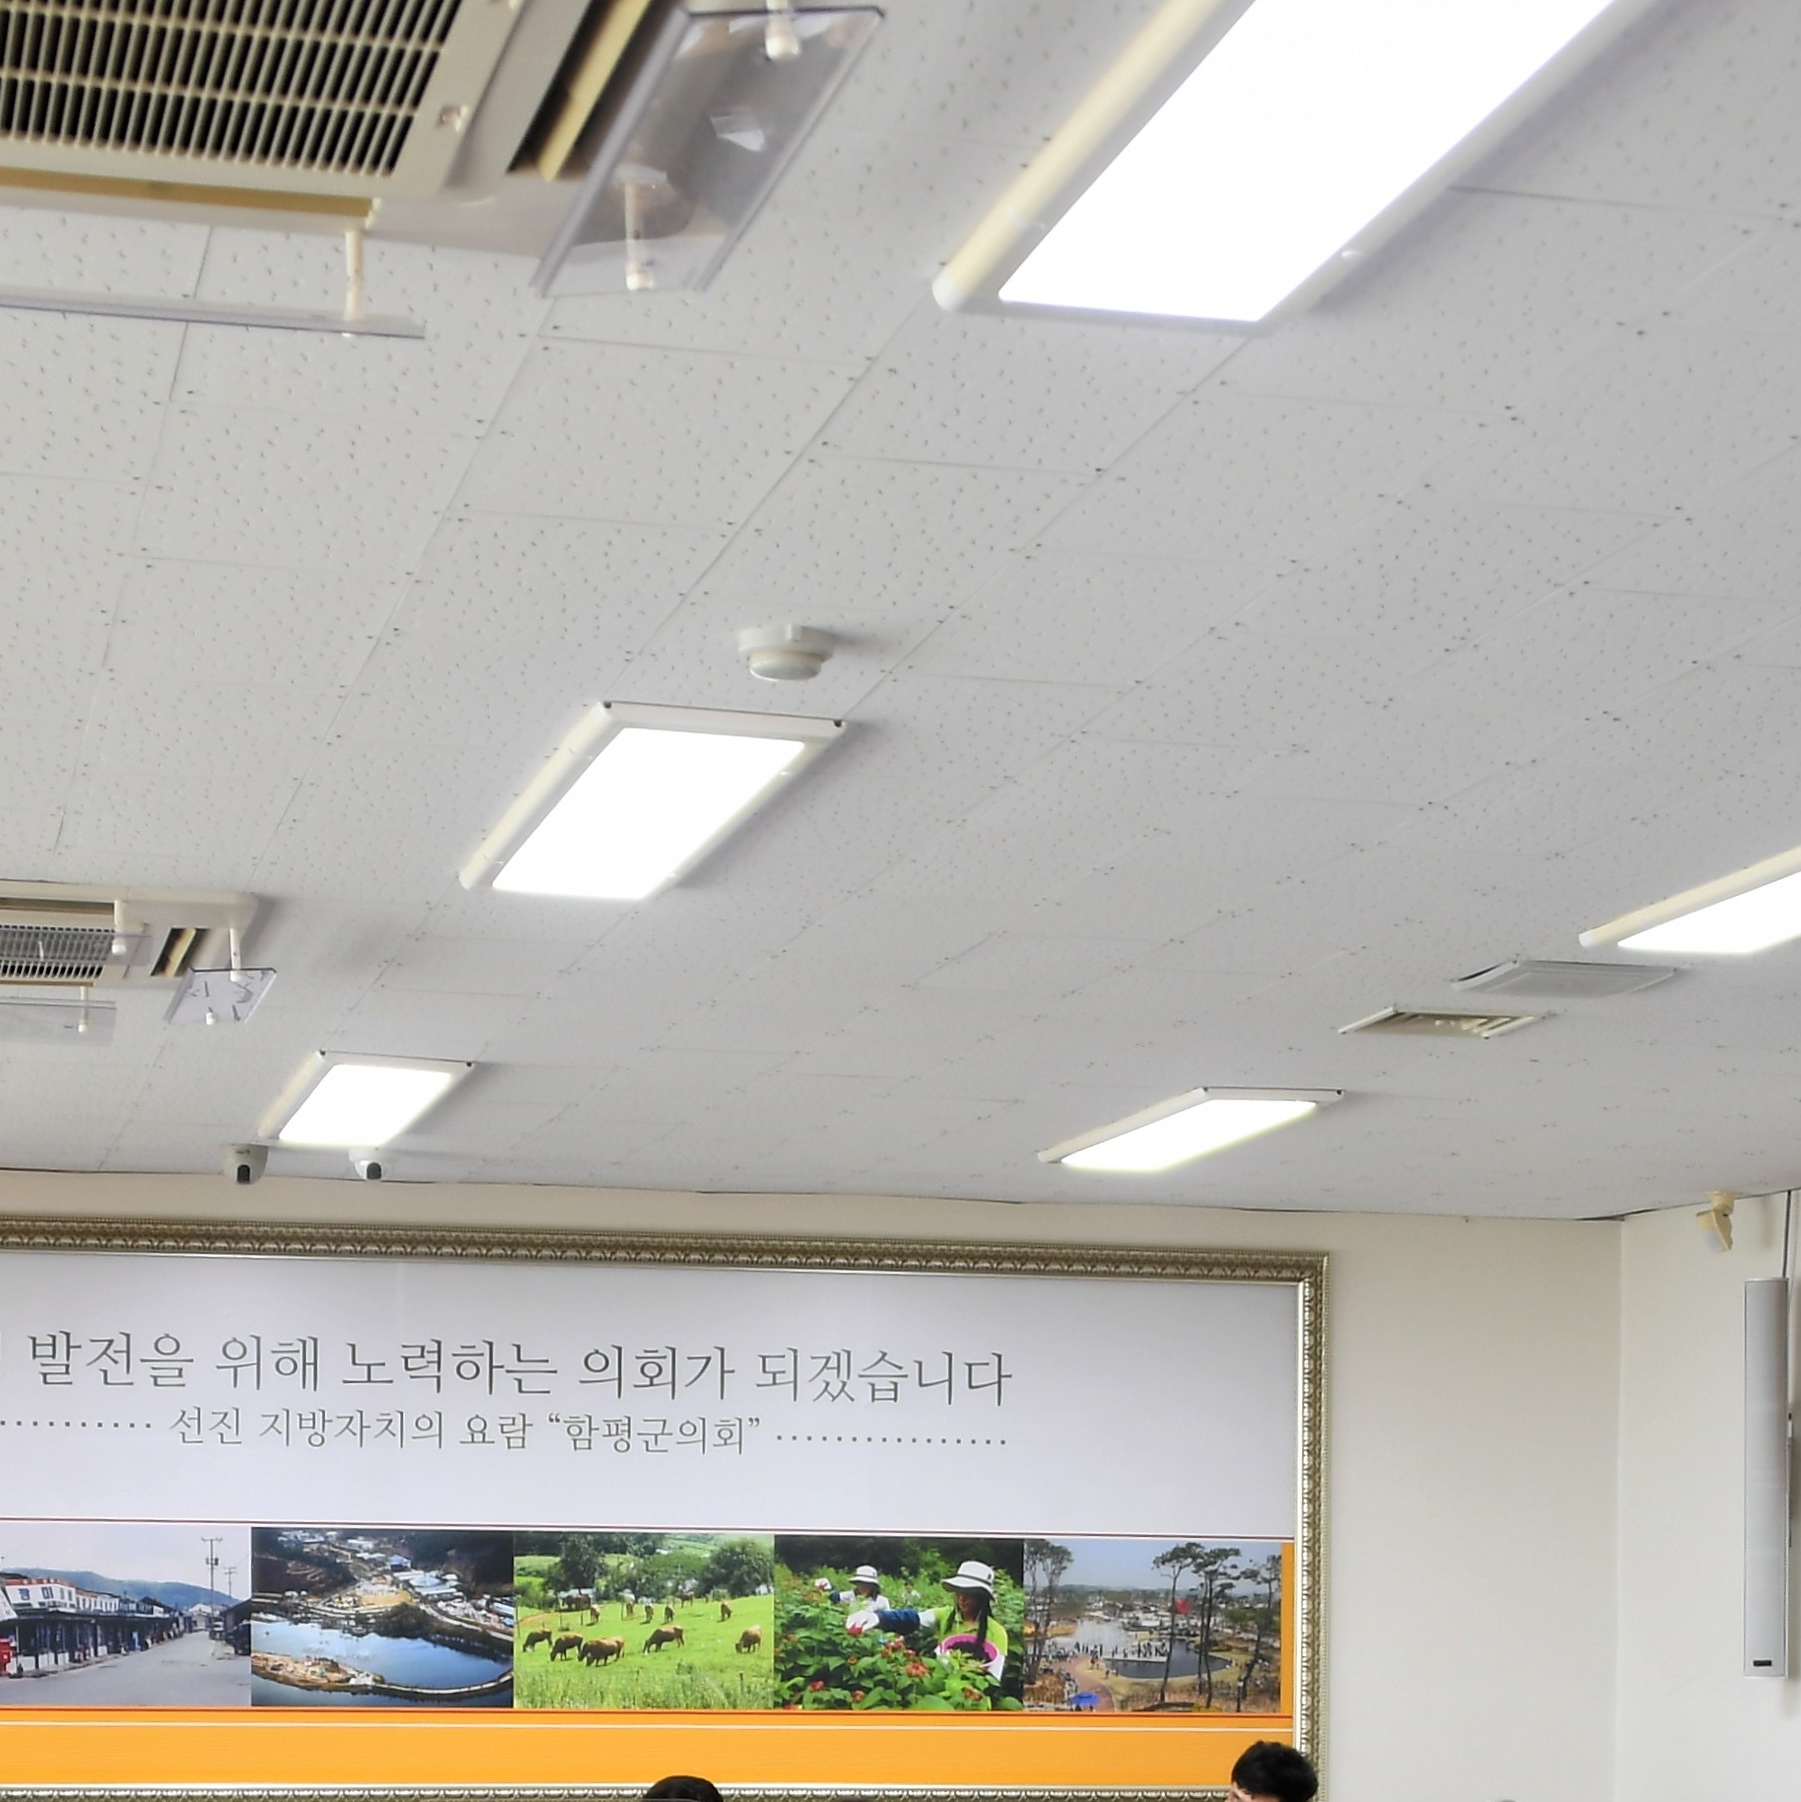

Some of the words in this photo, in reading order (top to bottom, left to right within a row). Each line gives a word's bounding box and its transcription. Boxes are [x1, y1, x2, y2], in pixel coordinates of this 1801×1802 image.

[28, 1330, 196, 1389] 발전을
[214, 1334, 321, 1392] 위해
[341, 1337, 559, 1397] 노력하는
[577, 1343, 736, 1402] 의회가
[754, 1347, 1013, 1407] 되겠습니다
[168, 1406, 244, 1448] 선진
[257, 1407, 446, 1451] 지방자치의
[458, 1412, 534, 1452] 요람
[547, 1411, 760, 1457] “함평군의회”
